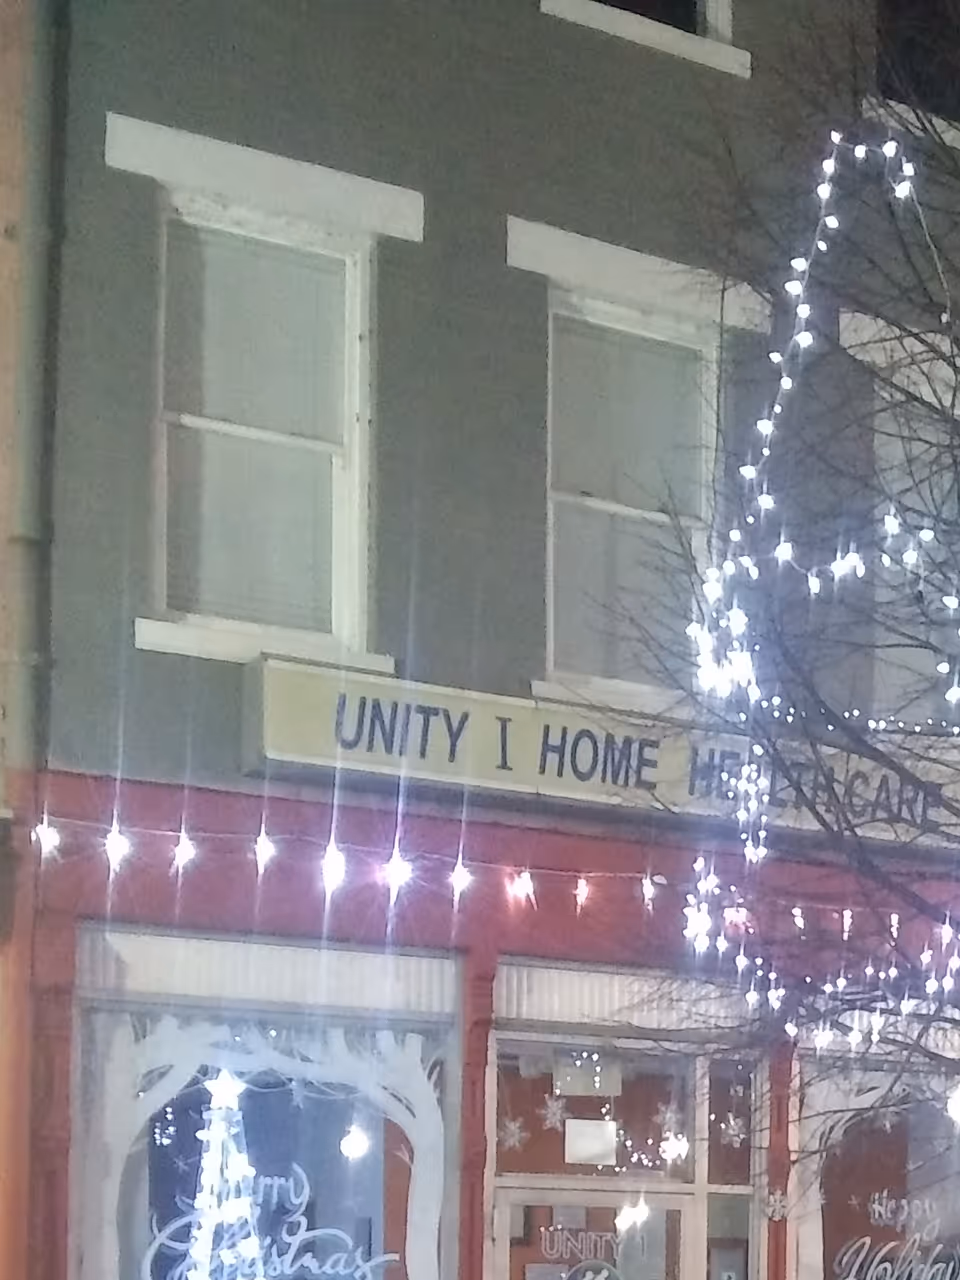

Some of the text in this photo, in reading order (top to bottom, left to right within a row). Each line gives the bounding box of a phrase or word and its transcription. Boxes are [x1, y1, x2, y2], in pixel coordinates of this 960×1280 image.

[334, 692, 471, 764] UNITY
[537, 723, 660, 791] HOME
[868, 1188, 942, 1244] Happy
[541, 1231, 622, 1260] UNITY
